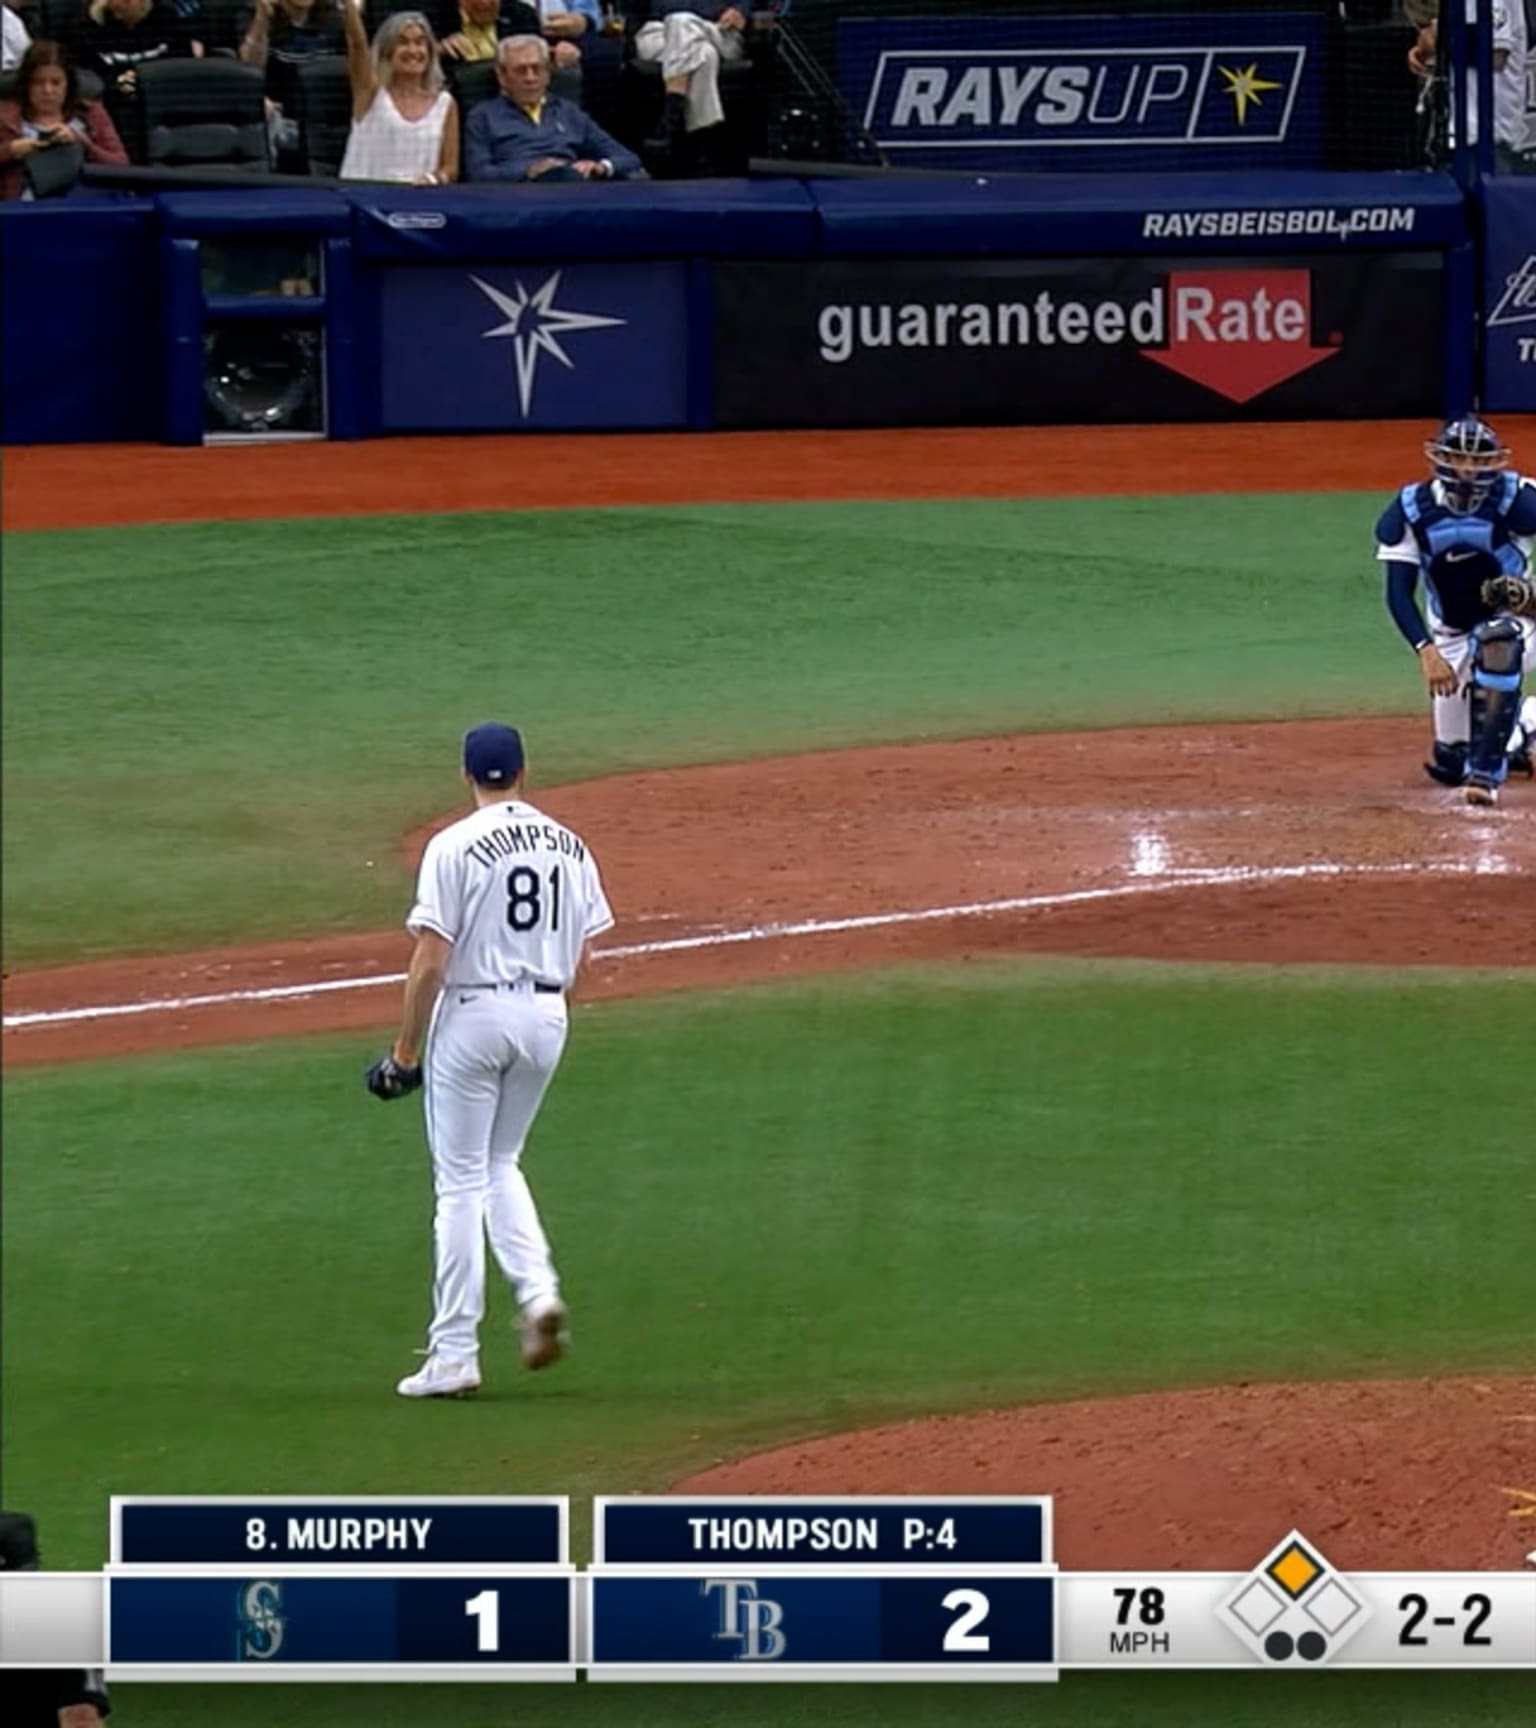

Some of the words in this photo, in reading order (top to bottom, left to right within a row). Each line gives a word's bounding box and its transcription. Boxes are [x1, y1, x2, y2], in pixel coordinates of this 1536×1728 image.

[1143, 208, 1415, 240] RAYSBEISBOL.COM
[818, 287, 1164, 362] guaranteed
[1176, 287, 1306, 342] Rate
[465, 824, 585, 868] THOMPSON
[506, 864, 559, 932] 81
